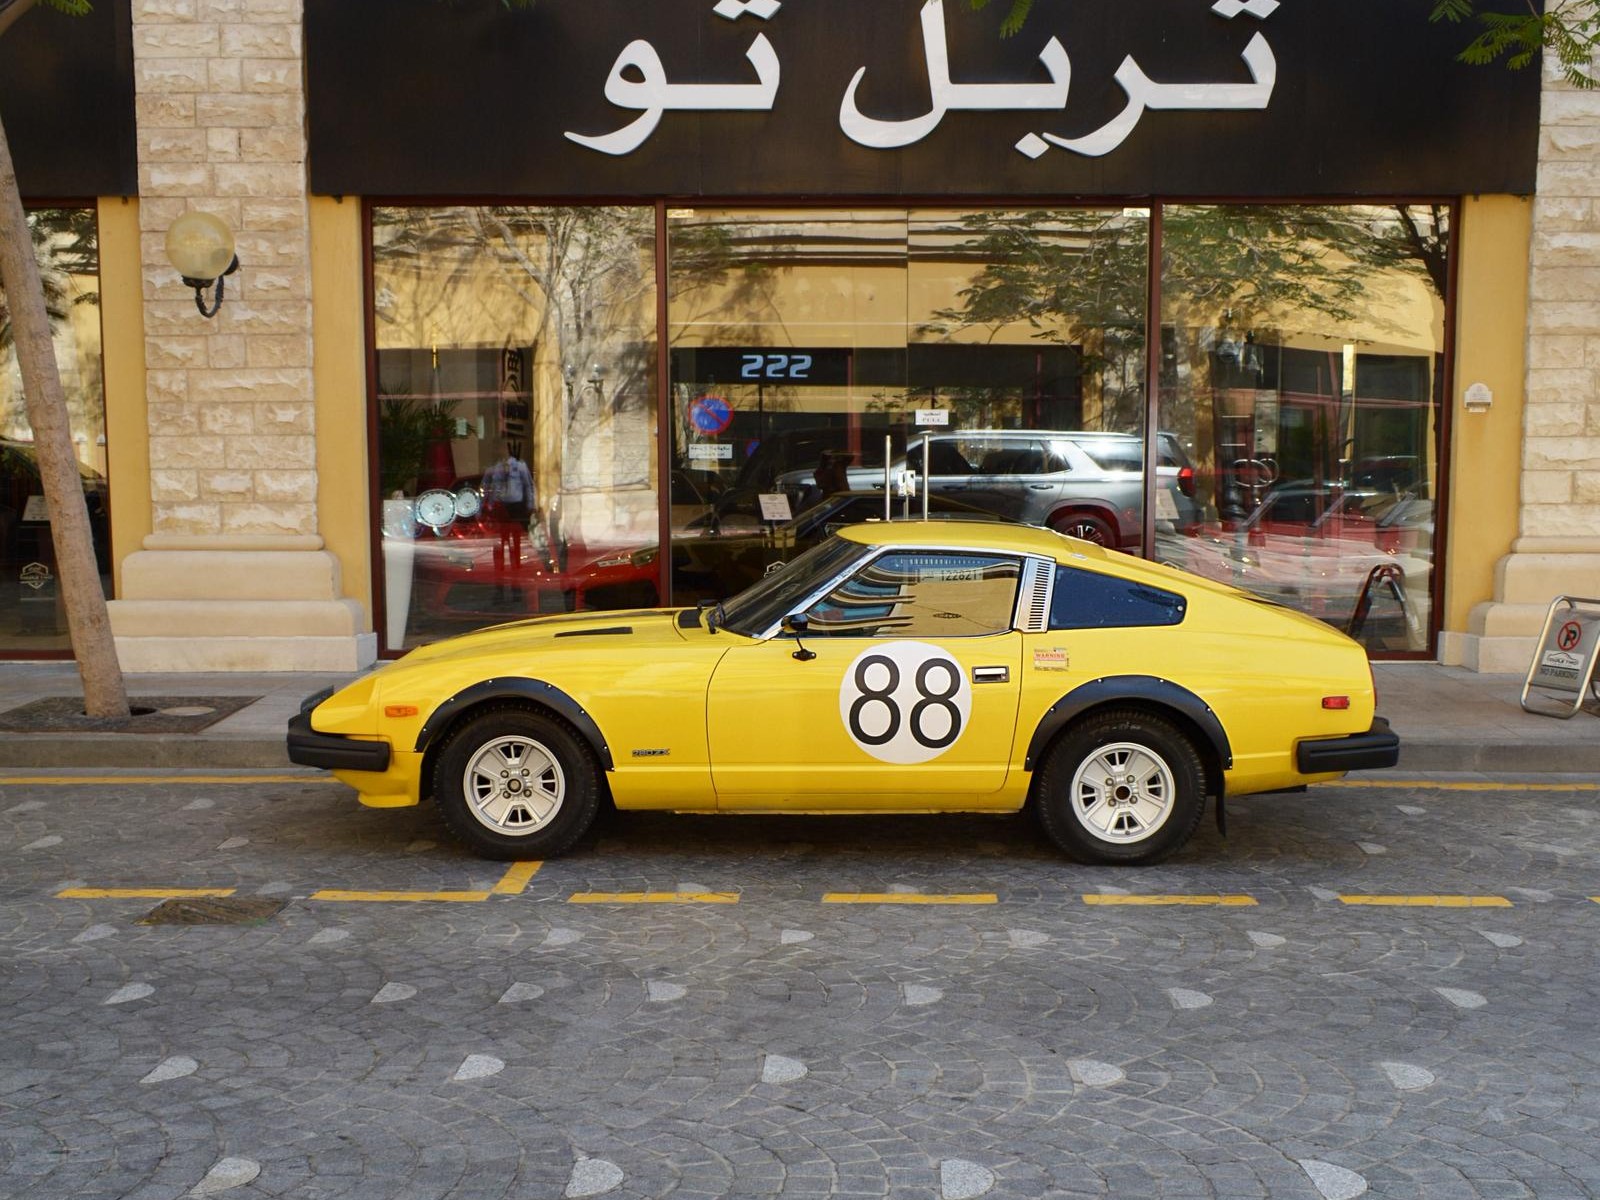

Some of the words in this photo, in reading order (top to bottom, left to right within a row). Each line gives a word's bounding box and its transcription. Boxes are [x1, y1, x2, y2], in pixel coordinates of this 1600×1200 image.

[563, 0, 782, 156] تو
[741, 354, 812, 378] 222
[849, 654, 962, 749] 88
